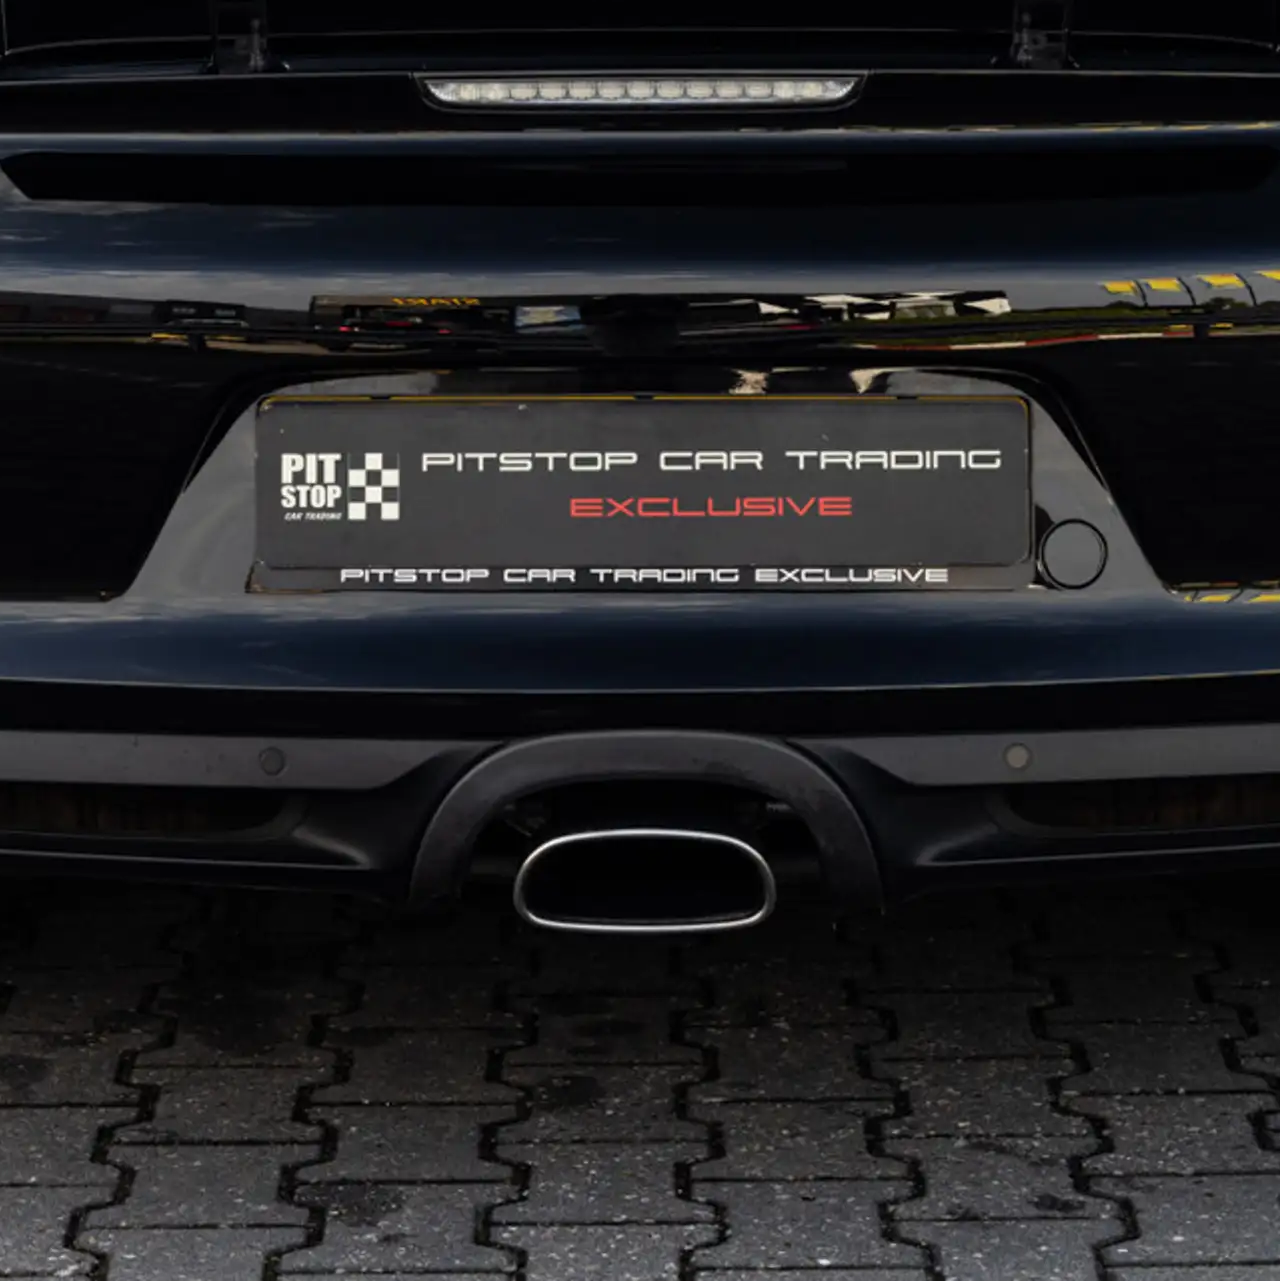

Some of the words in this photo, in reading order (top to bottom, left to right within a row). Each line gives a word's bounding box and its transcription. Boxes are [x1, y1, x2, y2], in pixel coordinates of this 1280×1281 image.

[280, 451, 342, 484] PIT
[421, 450, 639, 473] PITSTOP
[659, 450, 764, 472] CAR
[784, 449, 1002, 471] TRADING
[280, 483, 343, 509] STOP
[569, 495, 852, 518] EXCLUSIVE
[340, 568, 490, 584] PITSTOP
[503, 568, 576, 584] CAR
[589, 568, 740, 584] TRADING
[754, 568, 949, 584] EXCLUSIVE
